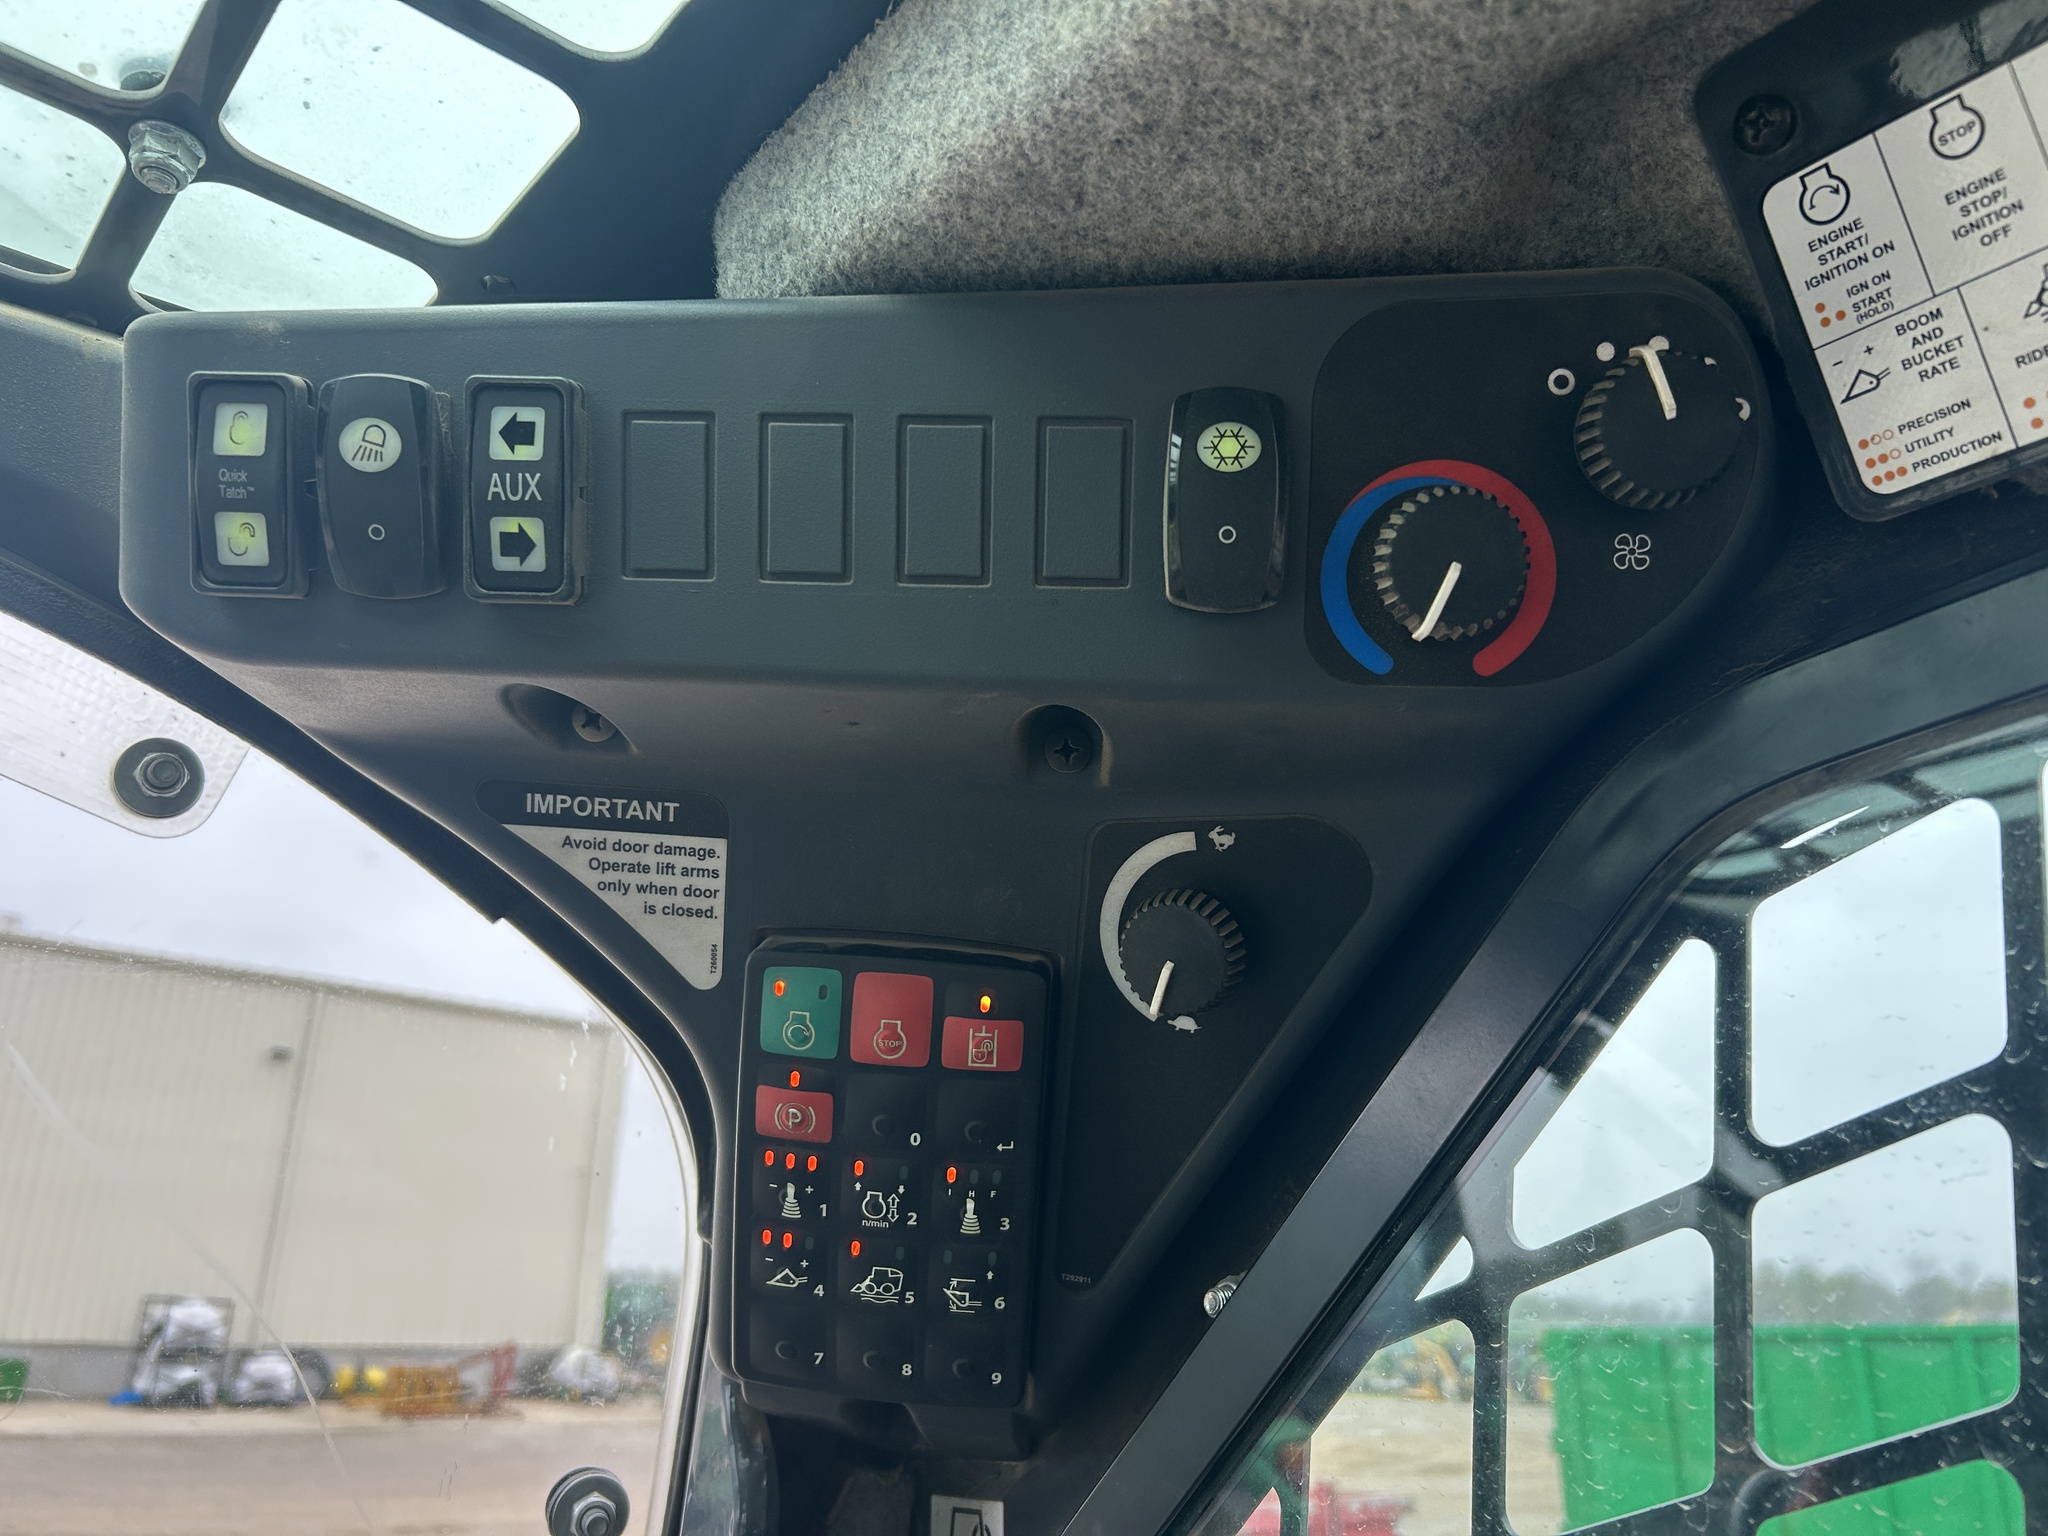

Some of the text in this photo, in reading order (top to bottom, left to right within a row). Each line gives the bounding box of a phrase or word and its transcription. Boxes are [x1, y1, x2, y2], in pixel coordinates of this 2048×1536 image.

[1937, 120, 1977, 147] STOP
[1944, 167, 2008, 206] ENGINE
[1959, 186, 2009, 218] STOP/
[1951, 199, 2025, 242] IGNITION
[1807, 217, 1865, 253] ENGINE
[1979, 223, 2013, 248] OFF
[1817, 232, 1870, 267] START/
[1804, 240, 1895, 291] IGNITION ON
[1846, 270, 1891, 298] IGN ON
[1852, 287, 1892, 313] START
[1856, 300, 1894, 325] (HOLD)
[1895, 307, 1944, 337] BOOM
[1911, 327, 1944, 349] AND
[1901, 335, 1965, 372] BUCKET
[1918, 356, 1961, 383] RATE
[1897, 398, 1972, 435] PRECISION
[1904, 426, 1955, 454] UTILITY
[1912, 431, 2003, 473] PRODUCTION
[219, 468, 248, 482] Quick
[487, 473, 542, 501] AUX
[526, 793, 680, 823] IMPORTANT
[561, 835, 720, 861] Avoid door damage.
[588, 857, 720, 879] Operate lift arms
[597, 879, 720, 899] only when door
[643, 901, 718, 920] is closed.
[710, 943, 718, 974] T260054
[877, 1039, 902, 1048] STOP
[787, 1108, 802, 1128] P
[910, 1132, 921, 1146] 0
[968, 1190, 975, 1198] H
[990, 1190, 997, 1198] F
[820, 1204, 827, 1217] 1
[907, 1212, 918, 1225] 2
[862, 1219, 889, 1229] n/min
[1000, 1217, 1010, 1231] 3
[813, 1285, 825, 1297] 4
[904, 1292, 915, 1304] 5
[994, 1297, 1006, 1309] 6
[814, 1353, 824, 1365] 7
[901, 1363, 913, 1376] 8
[991, 1372, 1002, 1385] 9
